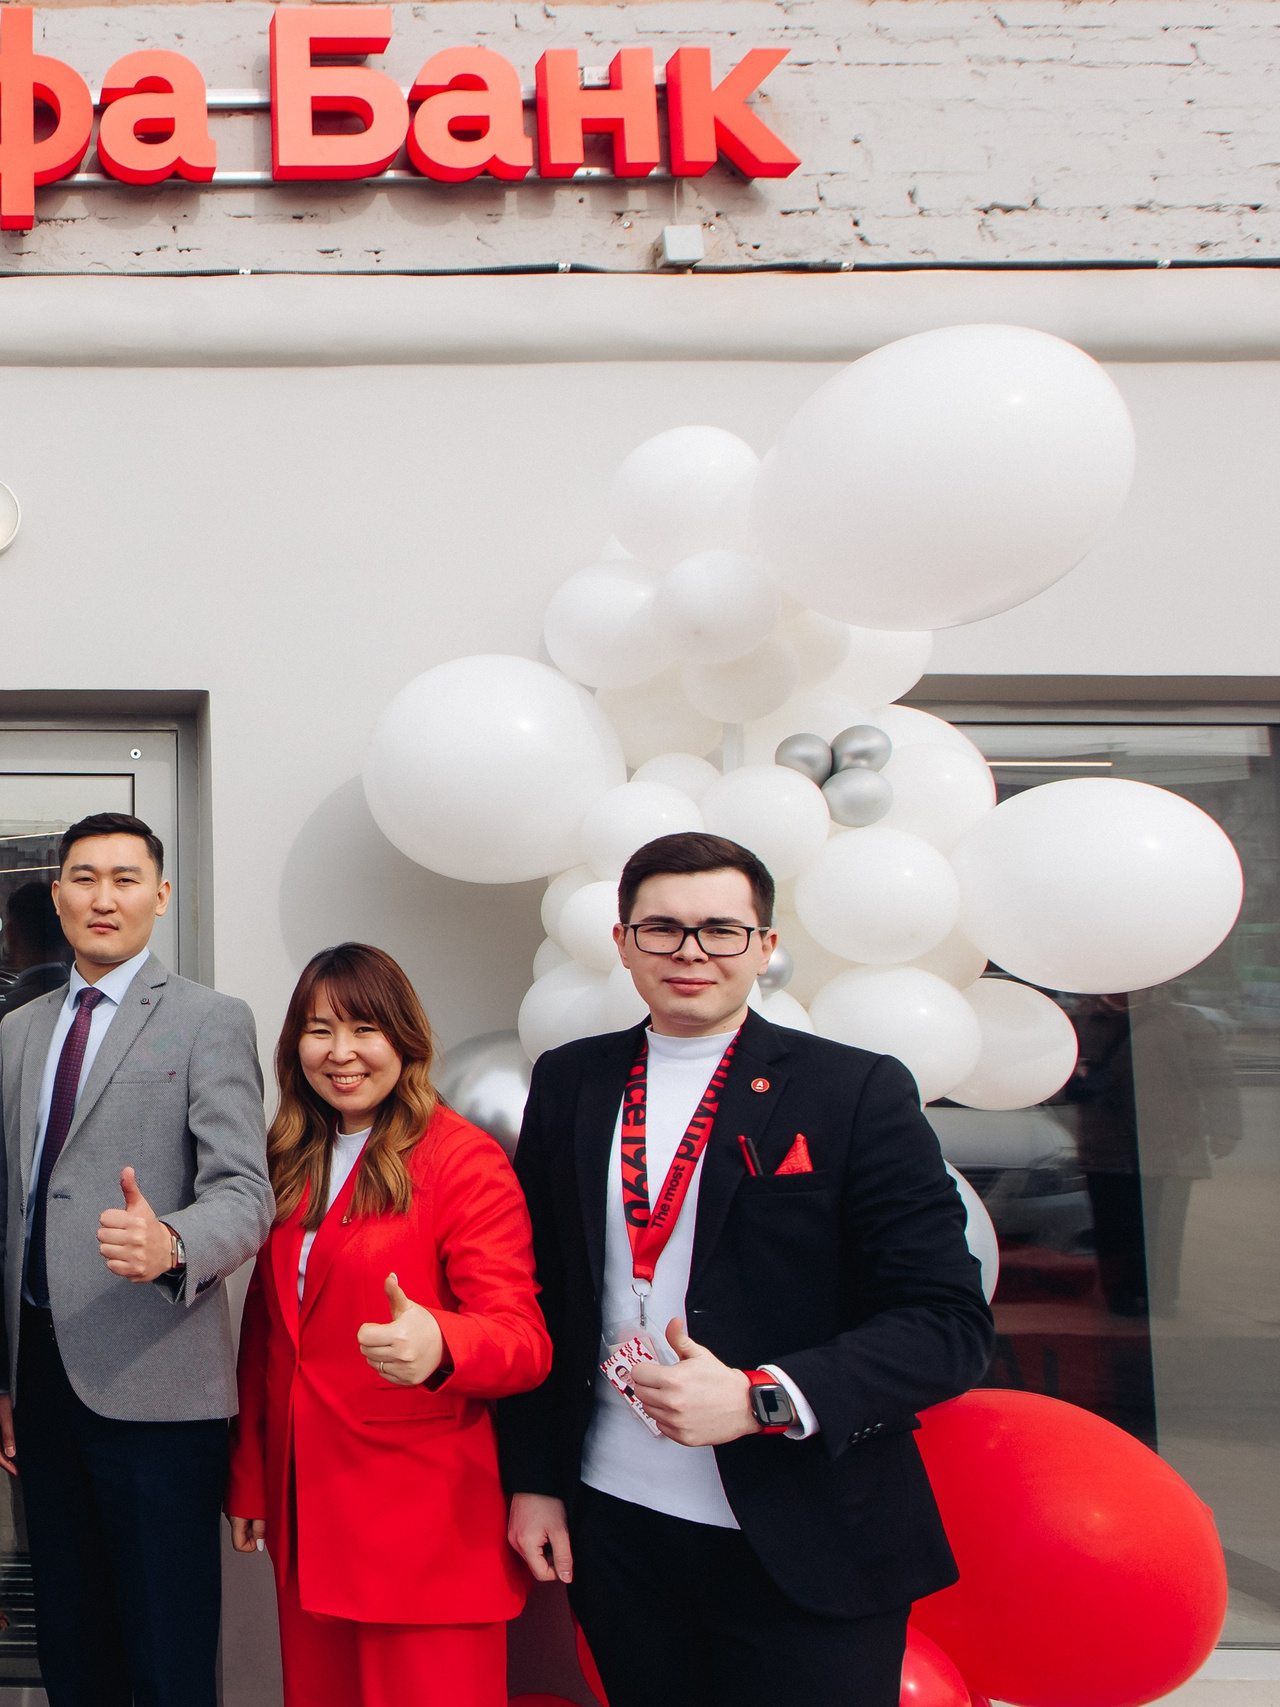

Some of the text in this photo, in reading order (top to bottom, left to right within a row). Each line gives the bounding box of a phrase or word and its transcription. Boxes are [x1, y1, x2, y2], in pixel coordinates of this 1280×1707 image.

[269, 5, 802, 183] Банк
[650, 1203, 670, 1229] The
[665, 1164, 686, 1202] most
